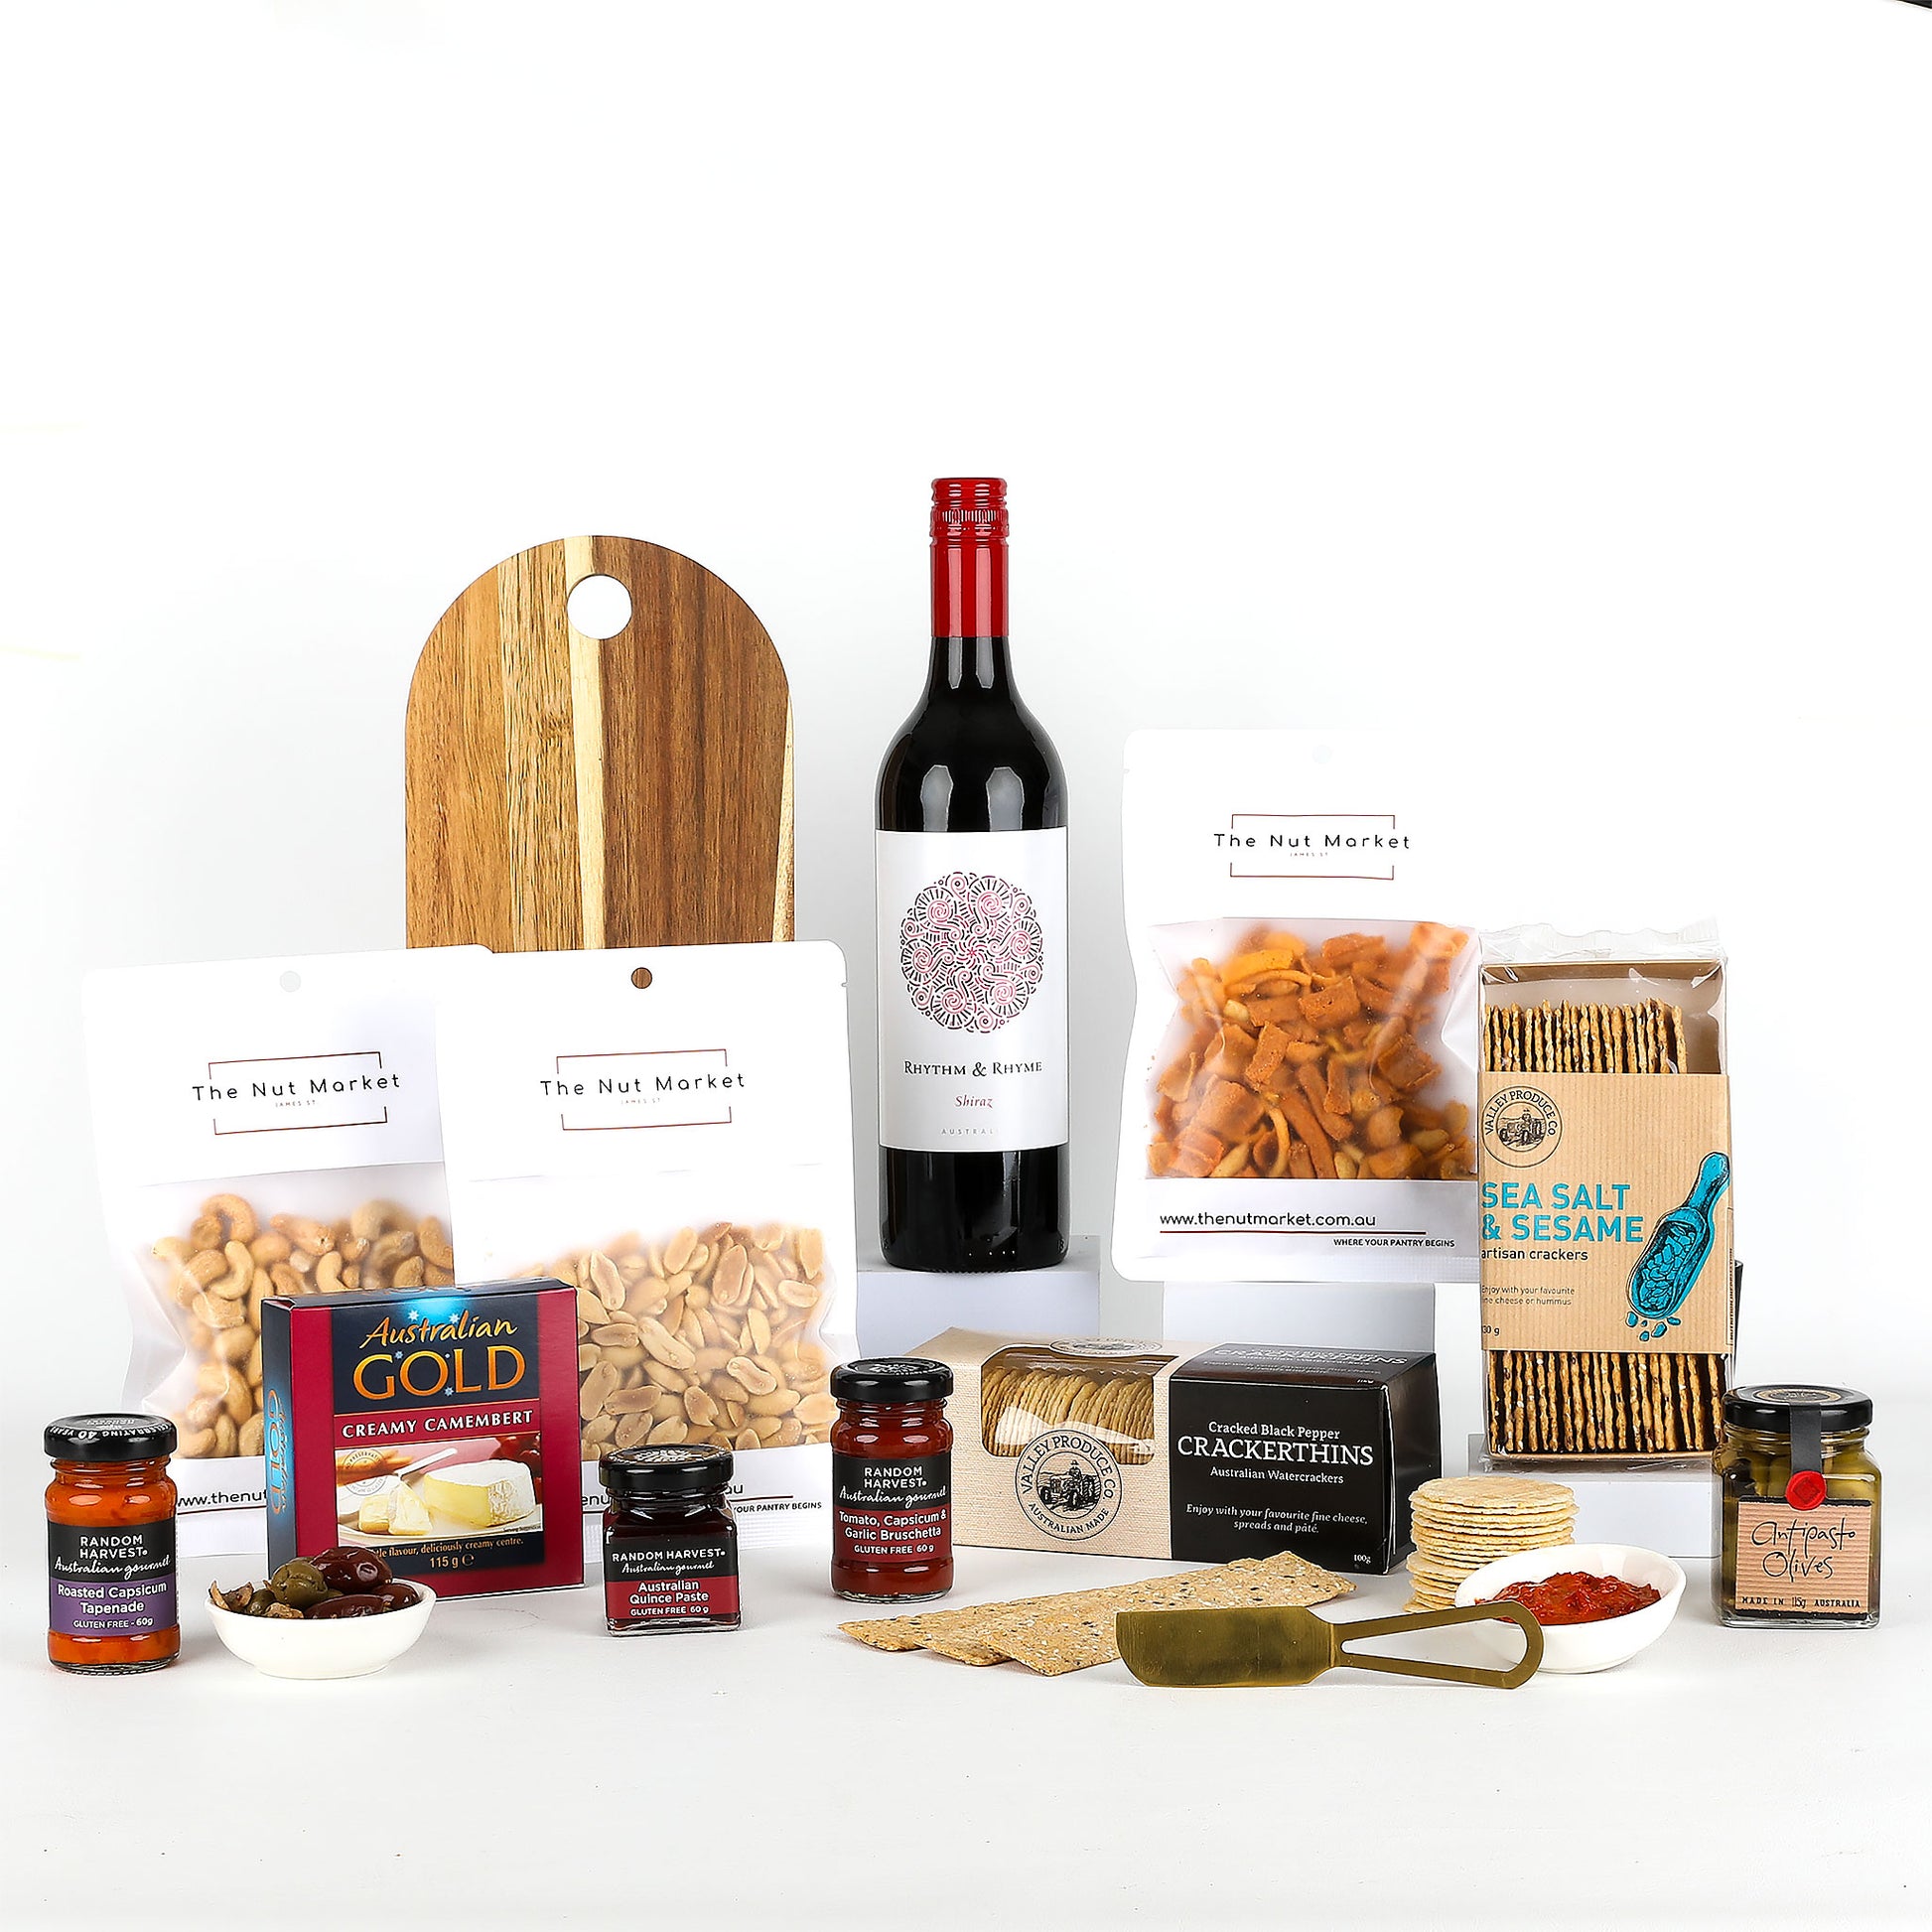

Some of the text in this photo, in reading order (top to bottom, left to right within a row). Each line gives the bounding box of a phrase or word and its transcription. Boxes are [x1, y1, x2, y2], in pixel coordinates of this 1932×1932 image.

[1213, 833, 1410, 849] The Nut Market
[972, 1061, 987, 1077] &
[192, 1073, 400, 1101] The Nut Market
[540, 1073, 745, 1096] The Nut Market
[955, 1095, 993, 1109] Shiraz
[1484, 1094, 1508, 1136] VALLEY
[1509, 1089, 1556, 1119] PRODUCE
[1482, 1182, 1630, 1210] SEA SALT
[1160, 1211, 1376, 1226] www.thenutmarket.com.au
[1482, 1214, 1644, 1242] & SESAME
[1365, 1238, 1389, 1247] YOUR
[1480, 1247, 1588, 1261] artisan crackers
[359, 1311, 518, 1348] Australian
[353, 1345, 525, 1401] GOLD
[343, 1410, 533, 1439] CREAMY CAMEMBERT
[1208, 1421, 1340, 1440] Cracked Black Pepper
[78, 1430, 97, 1440] 40
[268, 1389, 281, 1514] GOLD
[1177, 1436, 1373, 1465] CRACKERTHINS
[864, 1466, 922, 1477] RANDOM
[1021, 1440, 1051, 1494] VALLEY
[1052, 1435, 1113, 1476] PRODUCE
[1209, 1466, 1344, 1483] Australian Watercrackers
[864, 1478, 922, 1489] HARVEST
[839, 1485, 947, 1509] Australian gourmet
[757, 1502, 790, 1512] PANTRY
[791, 1501, 822, 1510] BEGINS
[1186, 1503, 1368, 1525] Enjoy with your favourite fine cheese,
[839, 1509, 947, 1528] Tomato, Capsicum &
[1029, 1502, 1110, 1534] AUSTRALIAN MADE
[1233, 1520, 1272, 1532] spreads
[1274, 1521, 1293, 1532] and
[80, 1535, 143, 1547] RANDOM
[845, 1525, 942, 1541] Garlic Bruschetta
[79, 1547, 142, 1559] HARVEST
[388, 1546, 419, 1557] flavour,
[421, 1541, 463, 1554] deliciously
[465, 1540, 493, 1551] creamy
[496, 1537, 524, 1547] centre.
[854, 1545, 889, 1555] GLUTEN
[890, 1545, 912, 1555] FREE
[430, 1557, 459, 1569] 115 g
[612, 1549, 721, 1562] RANDOM HARVEST
[1353, 1553, 1371, 1564] 100g
[55, 1555, 171, 1581] Australian gourmet
[621, 1561, 714, 1576] Australian gourmet
[1762, 1549, 1834, 1583] Olives
[58, 1582, 167, 1600] Roasted Capsicum
[637, 1581, 699, 1592] Australian
[629, 1591, 709, 1605] Quince Paste
[1741, 1596, 1768, 1605] MADE
[1814, 1598, 1861, 1607] AUSTRALIA
[80, 1600, 145, 1616] Tapenade
[630, 1607, 663, 1616] GLUTEN
[665, 1606, 686, 1615] FREE
[73, 1620, 106, 1629] GLUTEN
[106, 1619, 129, 1628] FREE
[136, 1617, 153, 1628] 60g
